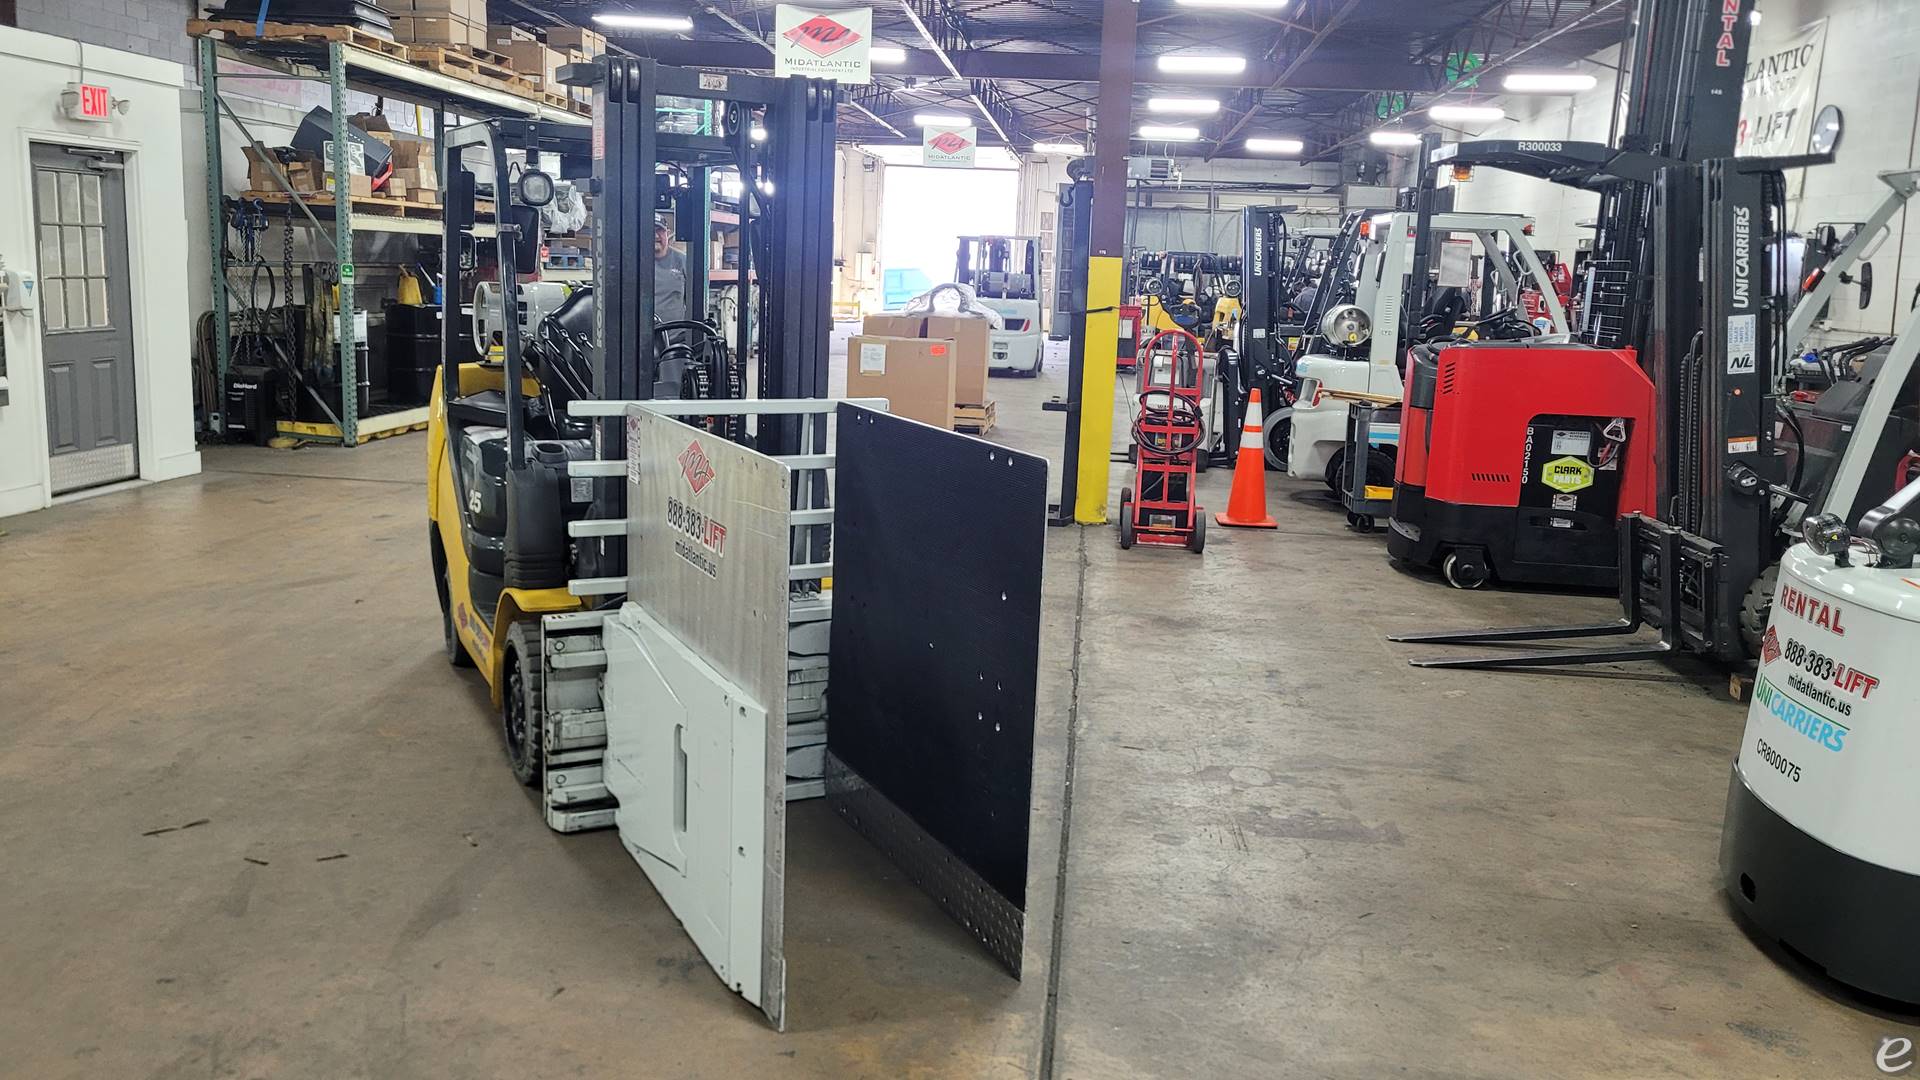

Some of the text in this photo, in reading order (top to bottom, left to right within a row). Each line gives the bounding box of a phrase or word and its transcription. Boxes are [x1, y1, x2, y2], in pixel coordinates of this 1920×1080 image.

[785, 58, 861, 68] MIDATLANTIC
[81, 86, 107, 117] EXIT
[1518, 142, 1562, 152] R300033
[1254, 227, 1262, 276] UNICARRIERS
[1733, 205, 1750, 308] UNICARRIERS
[1522, 427, 1534, 484] BA02150
[1554, 465, 1582, 475] CLARK
[1553, 475, 1581, 484] PARTS
[469, 489, 482, 514] 25
[674, 540, 717, 578] midatlantic.us
[1780, 583, 1845, 636] RENTAL
[1756, 673, 1848, 752] UNICARRIERS
[1787, 673, 1851, 717] midatlantic.us
[1756, 738, 1802, 783] CR800075
